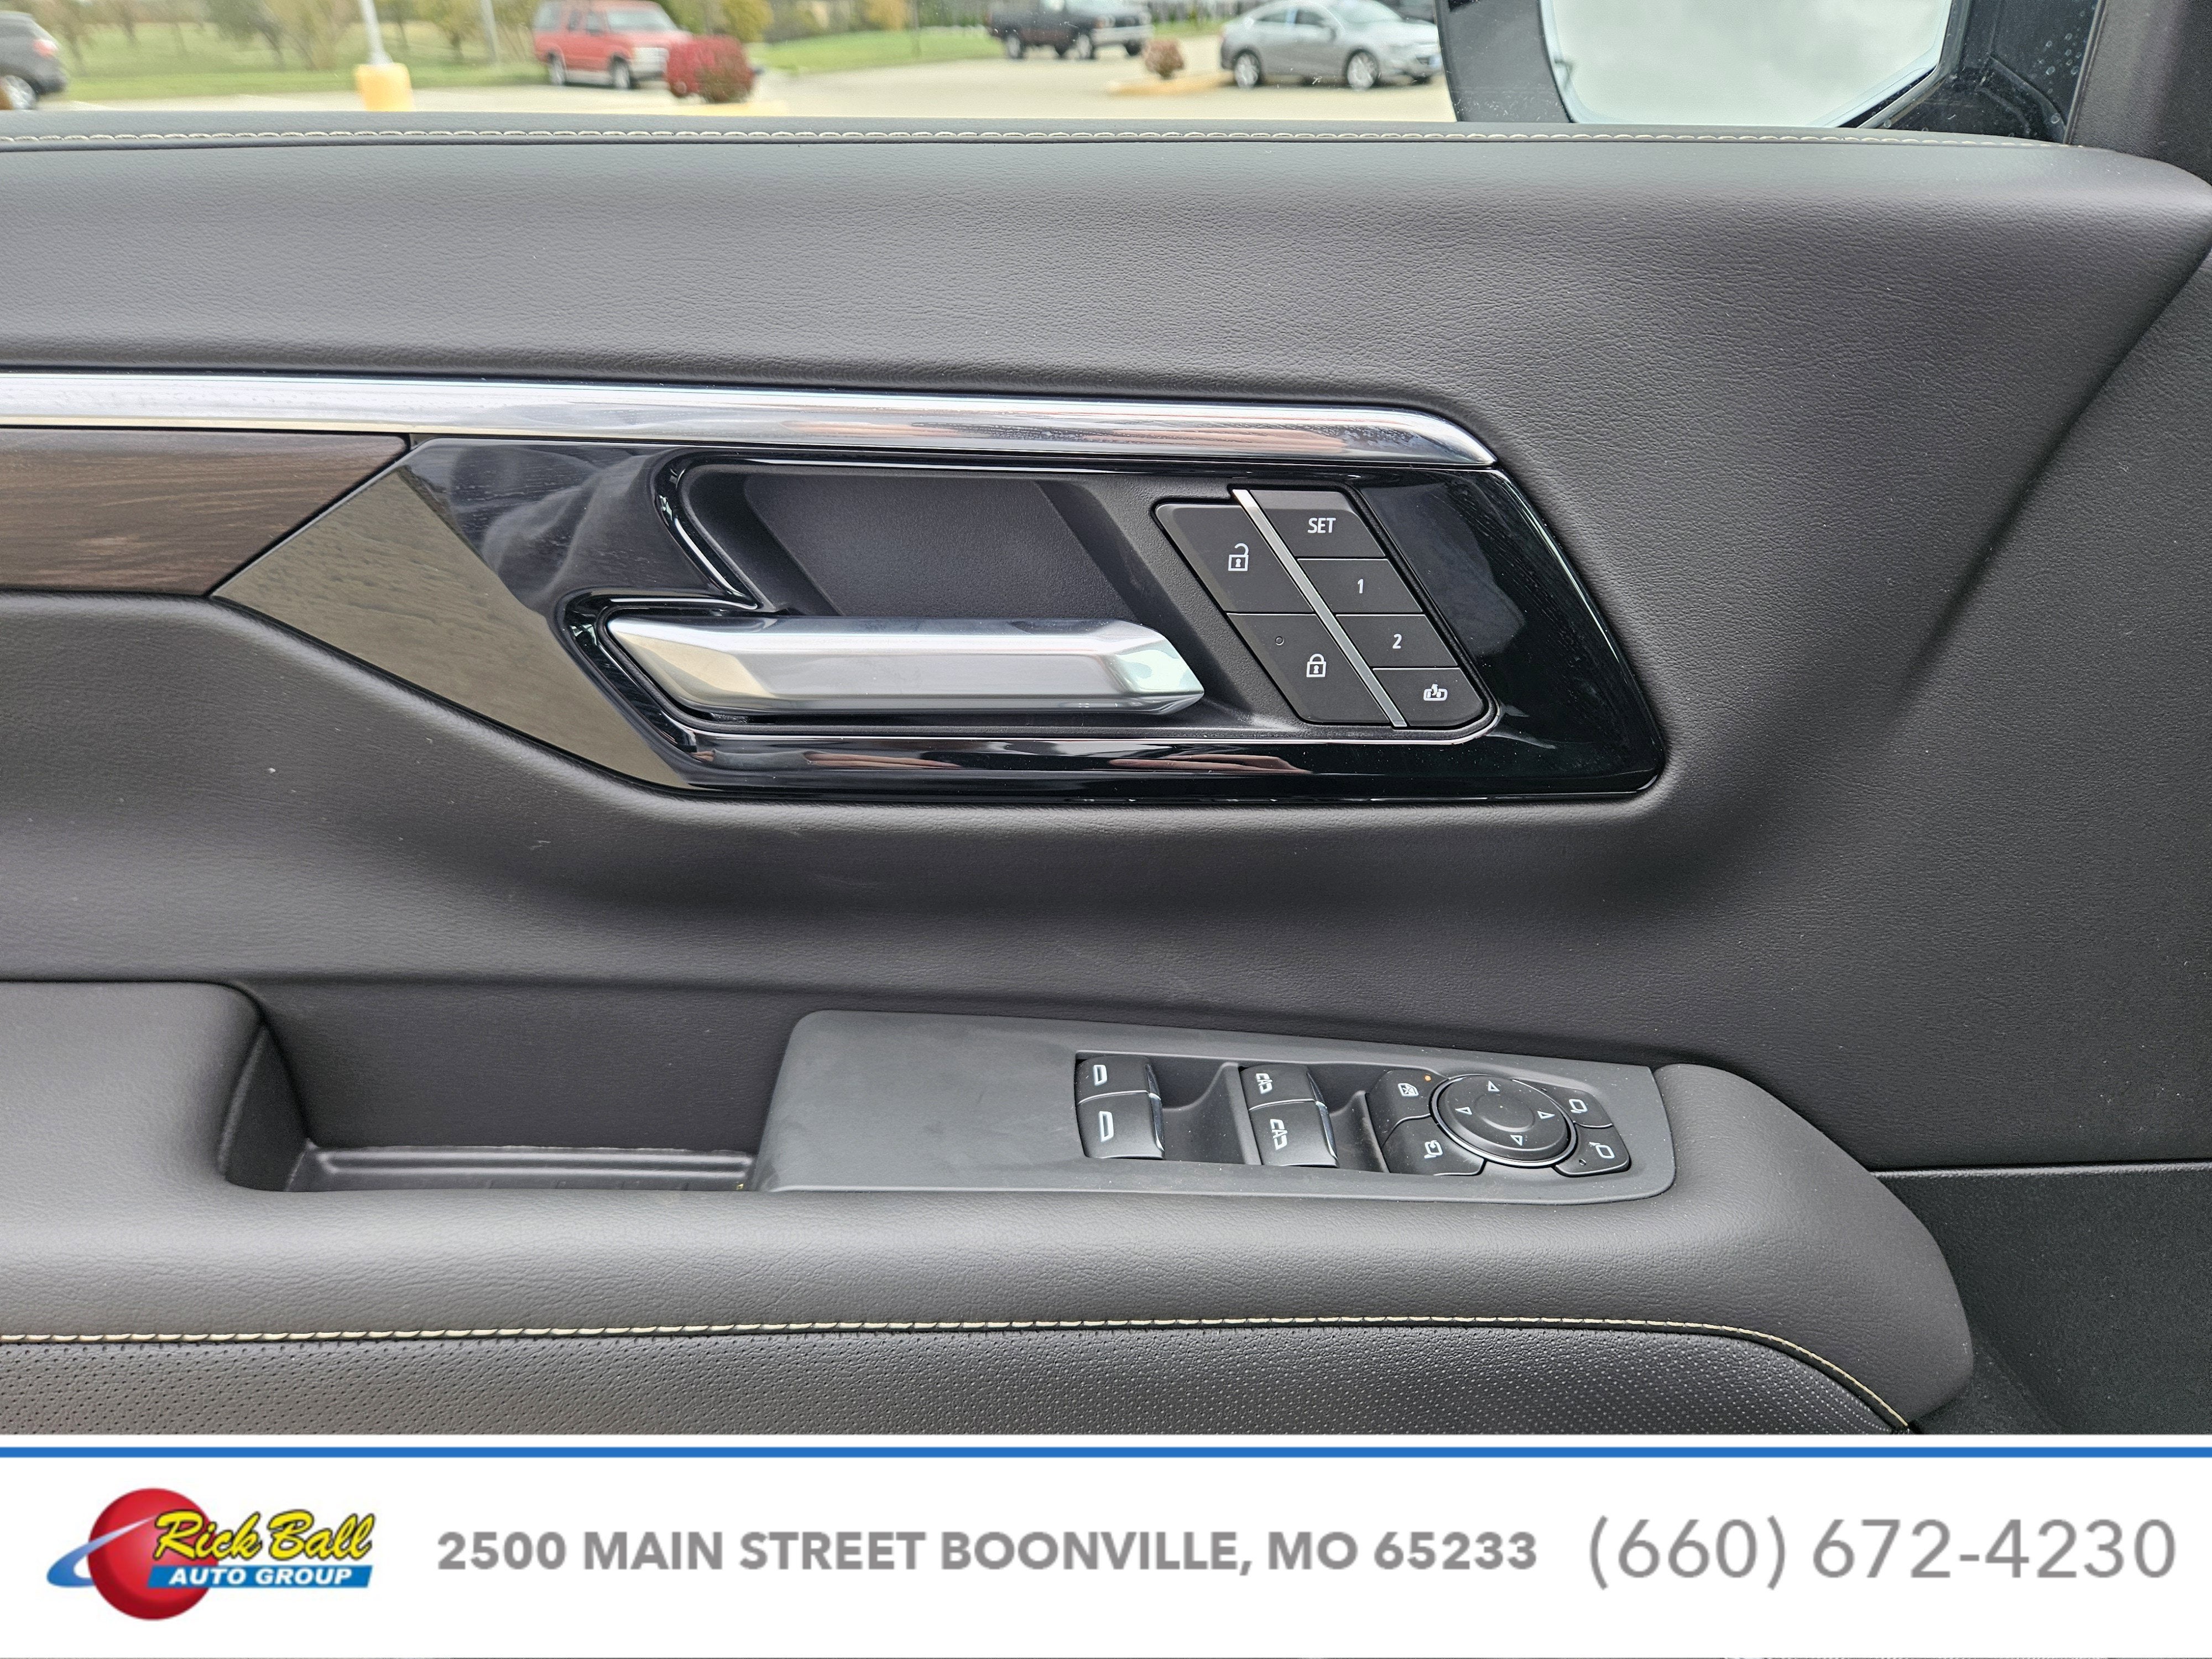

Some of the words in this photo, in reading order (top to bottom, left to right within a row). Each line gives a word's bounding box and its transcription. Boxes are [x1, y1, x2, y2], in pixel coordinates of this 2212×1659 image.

[1307, 517, 1337, 534] SET
[1357, 578, 1364, 594] 1
[1391, 633, 1402, 650] 2
